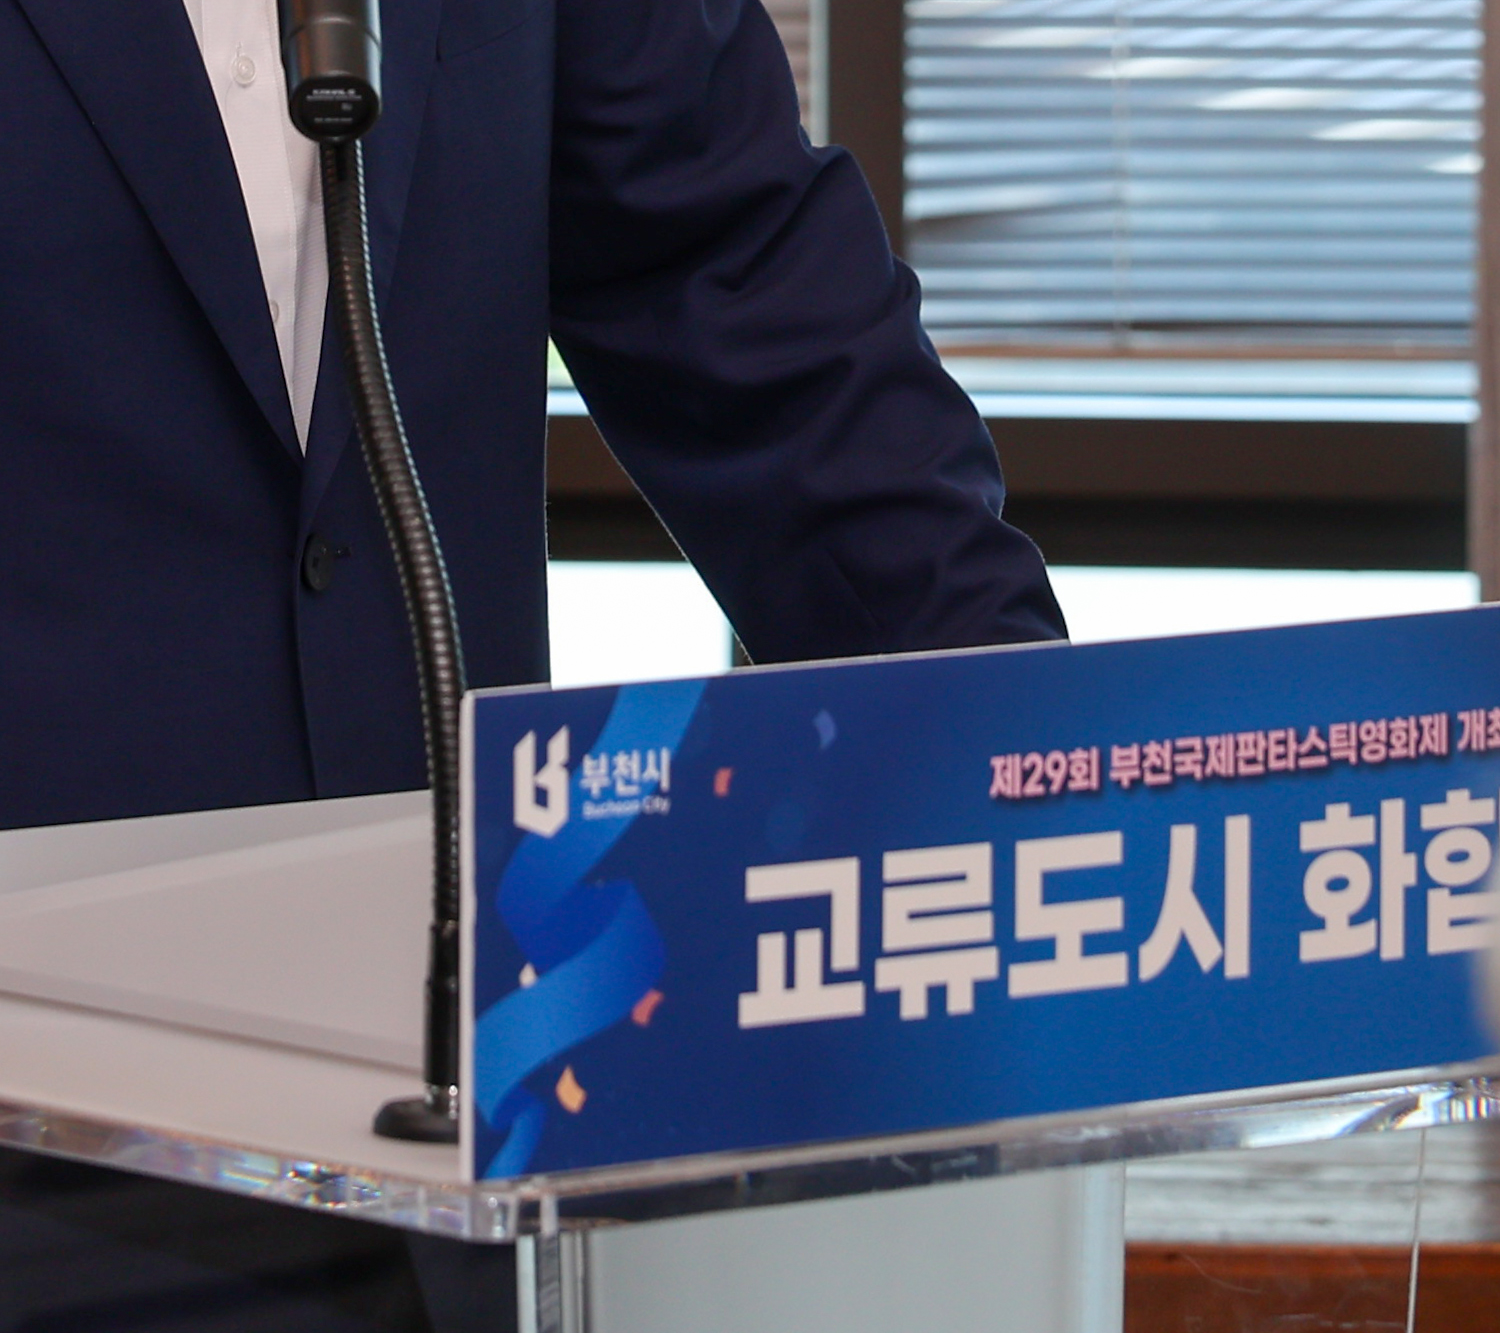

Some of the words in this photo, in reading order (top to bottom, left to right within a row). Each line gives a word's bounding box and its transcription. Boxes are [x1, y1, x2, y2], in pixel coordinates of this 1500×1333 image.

[580, 746, 671, 799] 부천시
[989, 746, 1099, 798] 제29회
[1109, 712, 1449, 789] 부천국제판타스틱영화제
[738, 814, 1251, 1030] 교류도시
